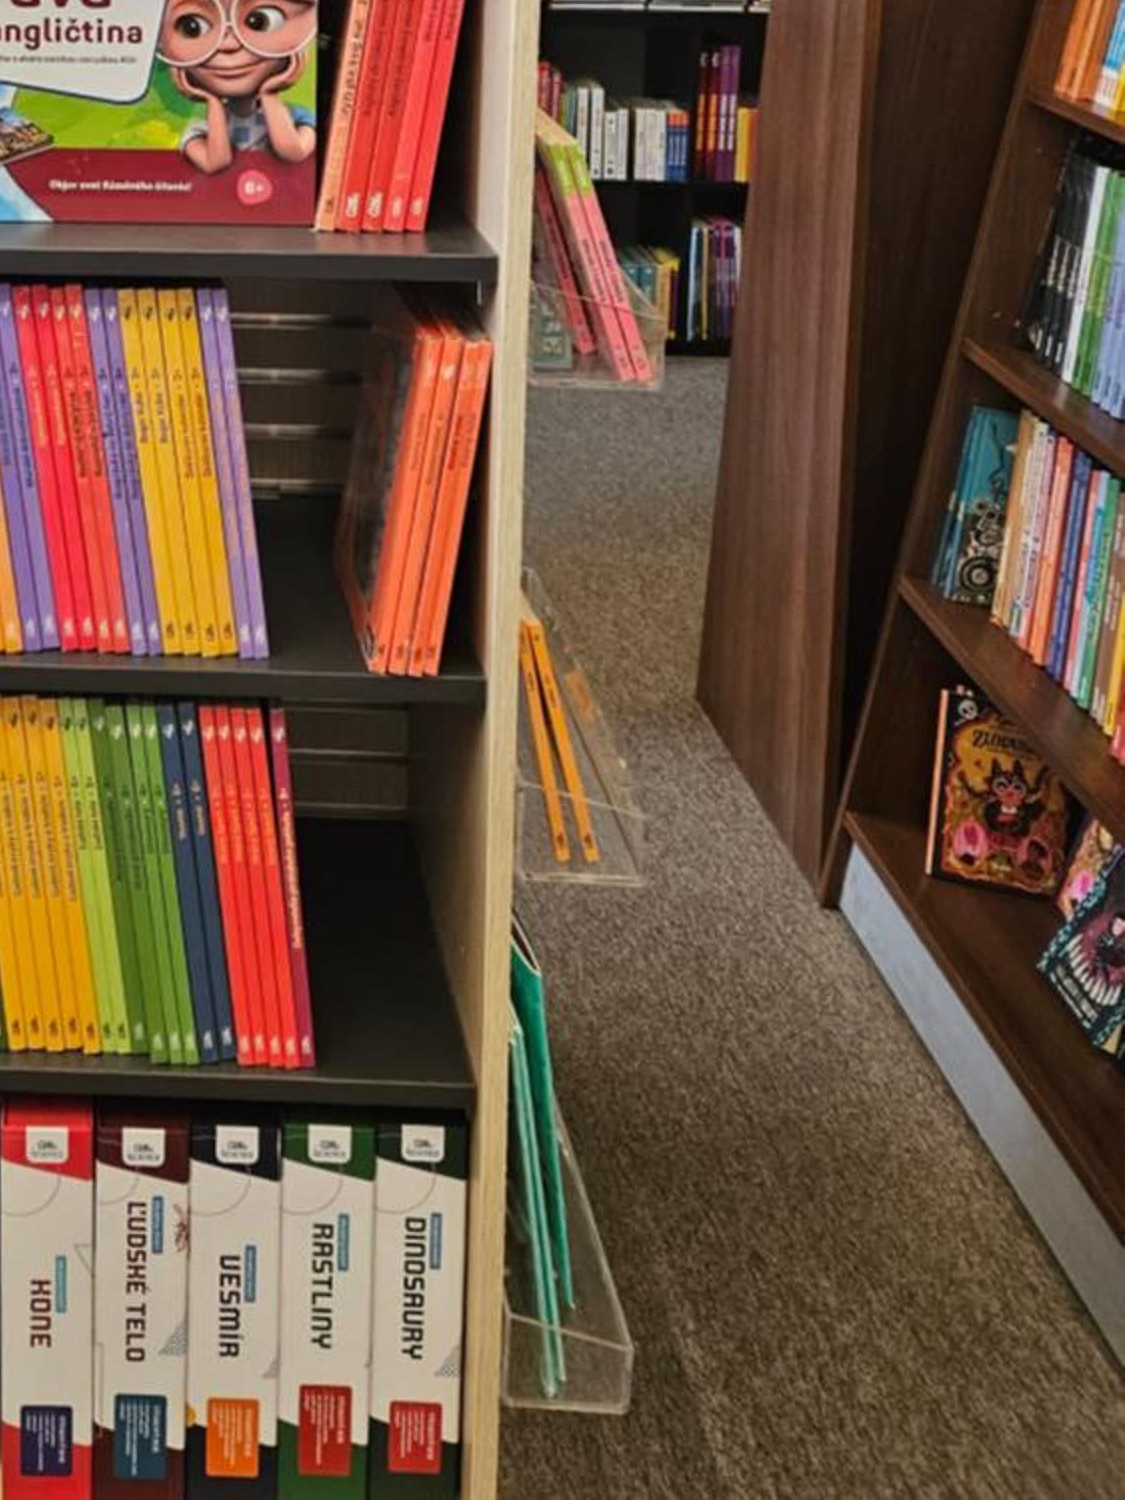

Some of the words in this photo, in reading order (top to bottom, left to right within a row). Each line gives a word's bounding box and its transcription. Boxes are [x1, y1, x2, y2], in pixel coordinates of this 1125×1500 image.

[30, 1278, 52, 1349] KONE
[125, 1304, 147, 1363] TELO
[218, 1255, 244, 1358] VESMÍR
[310, 1223, 335, 1349] RASTLINY
[402, 1217, 426, 1361] DINOSAURY
